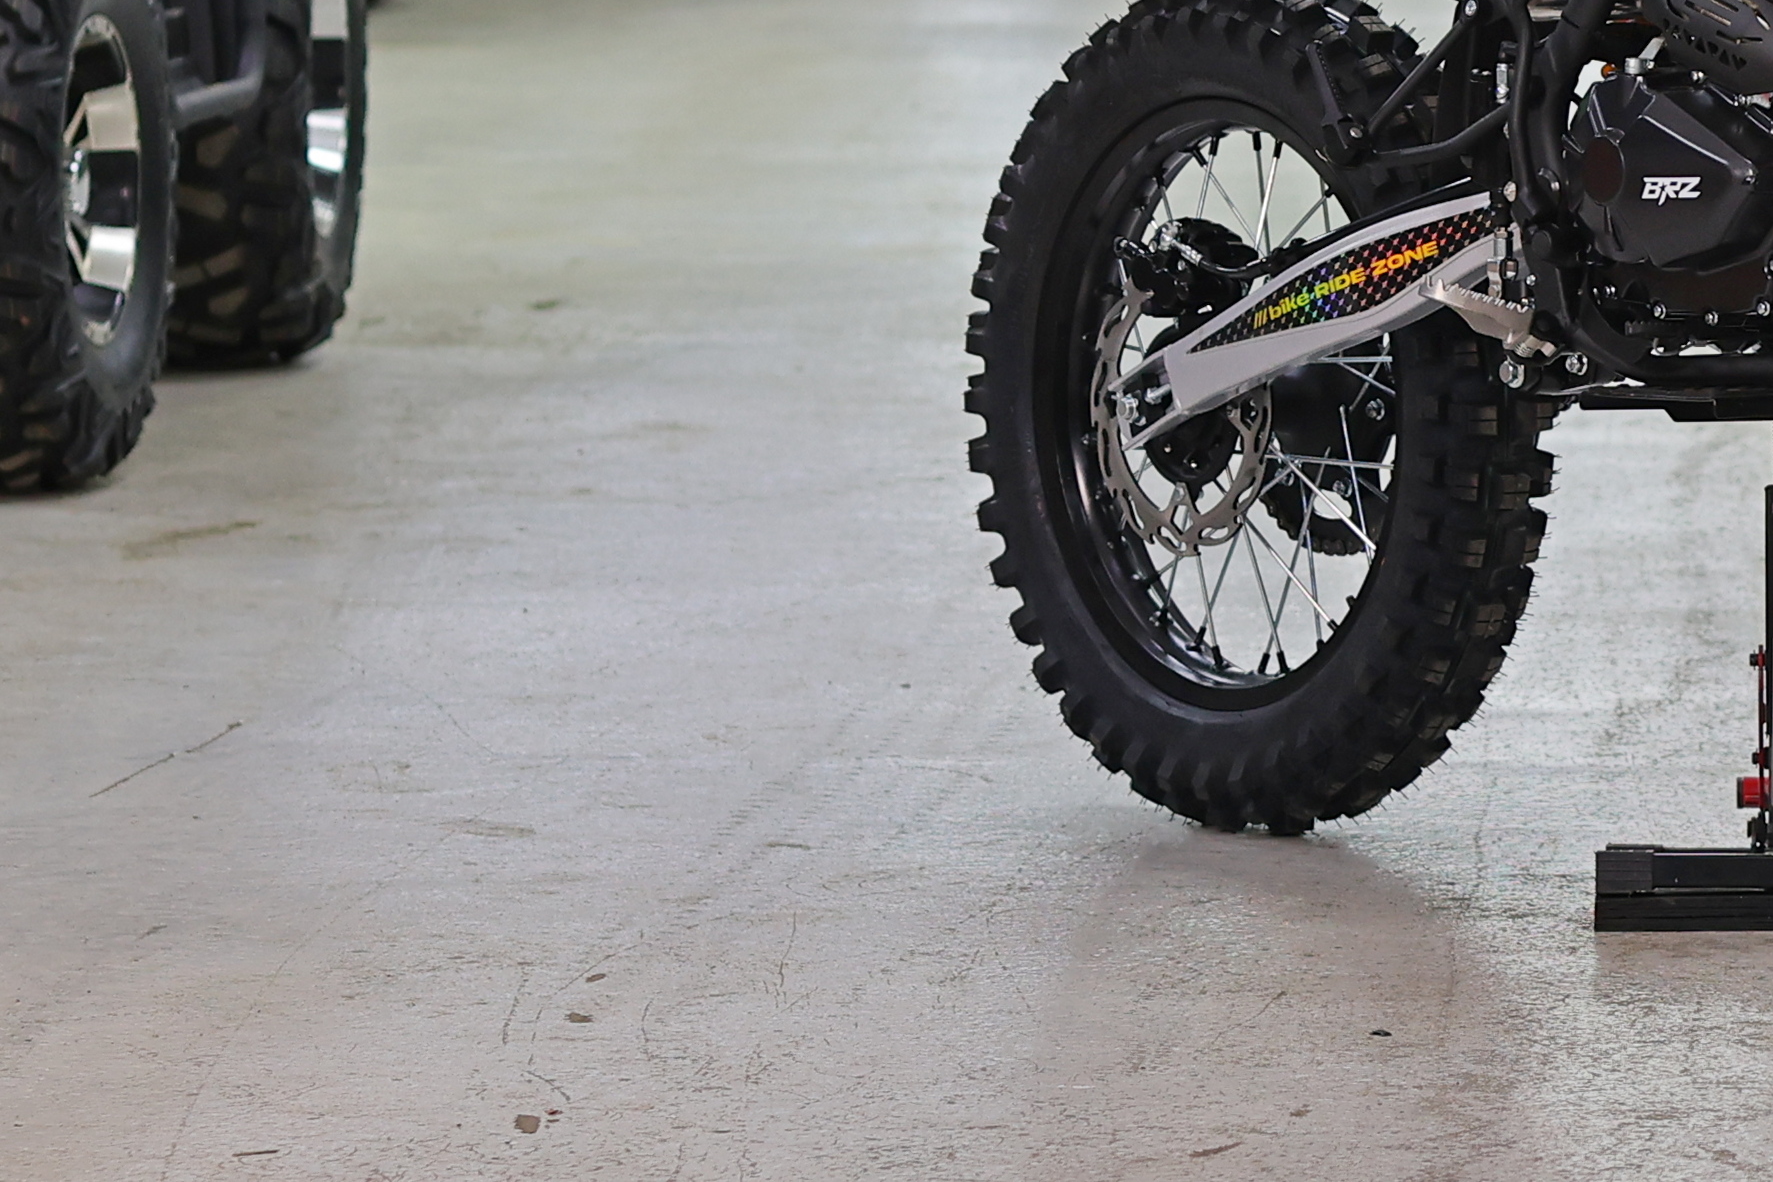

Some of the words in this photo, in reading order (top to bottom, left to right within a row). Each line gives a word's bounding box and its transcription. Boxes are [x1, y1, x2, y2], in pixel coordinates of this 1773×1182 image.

[1641, 176, 1702, 206] BRZ
[1268, 292, 1311, 321] bike
[1313, 267, 1367, 299] RIDE
[1370, 241, 1440, 276] ZONE
